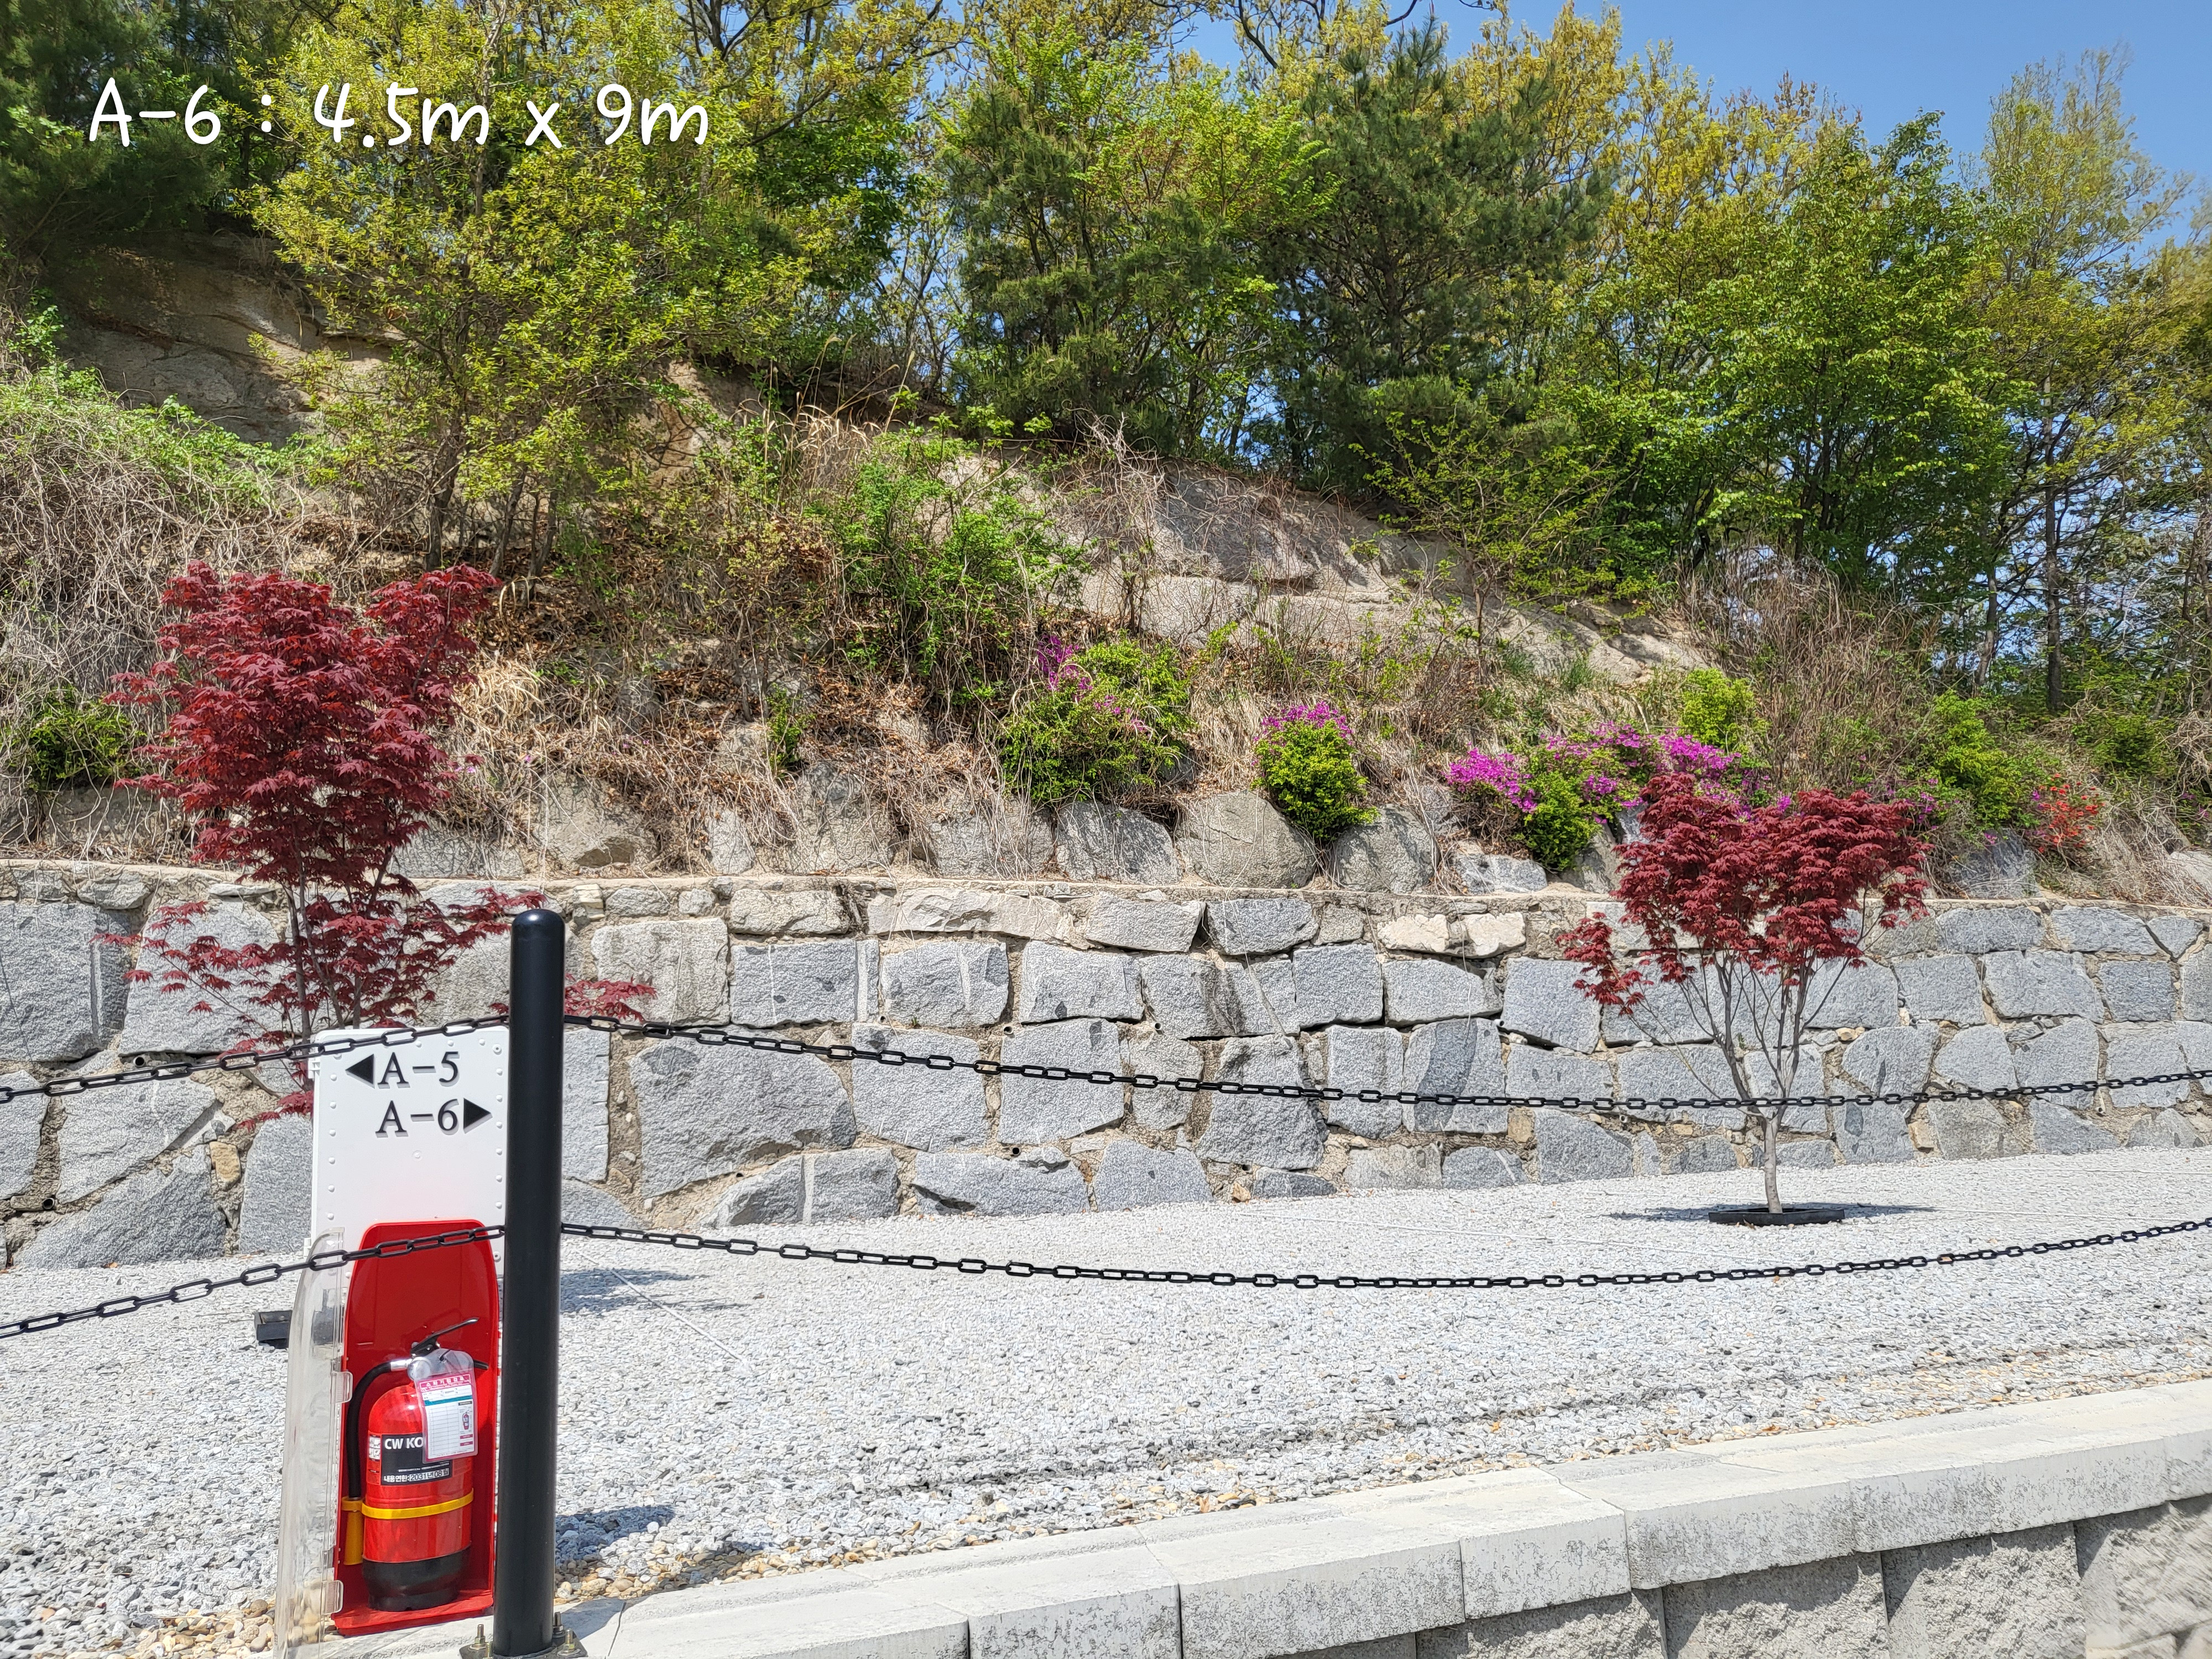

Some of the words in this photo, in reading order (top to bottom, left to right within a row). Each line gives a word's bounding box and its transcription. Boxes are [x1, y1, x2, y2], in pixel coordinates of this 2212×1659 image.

[378, 1051, 460, 1087] A-5
[375, 1098, 460, 1136] A-6
[384, 1438, 404, 1449] CW
